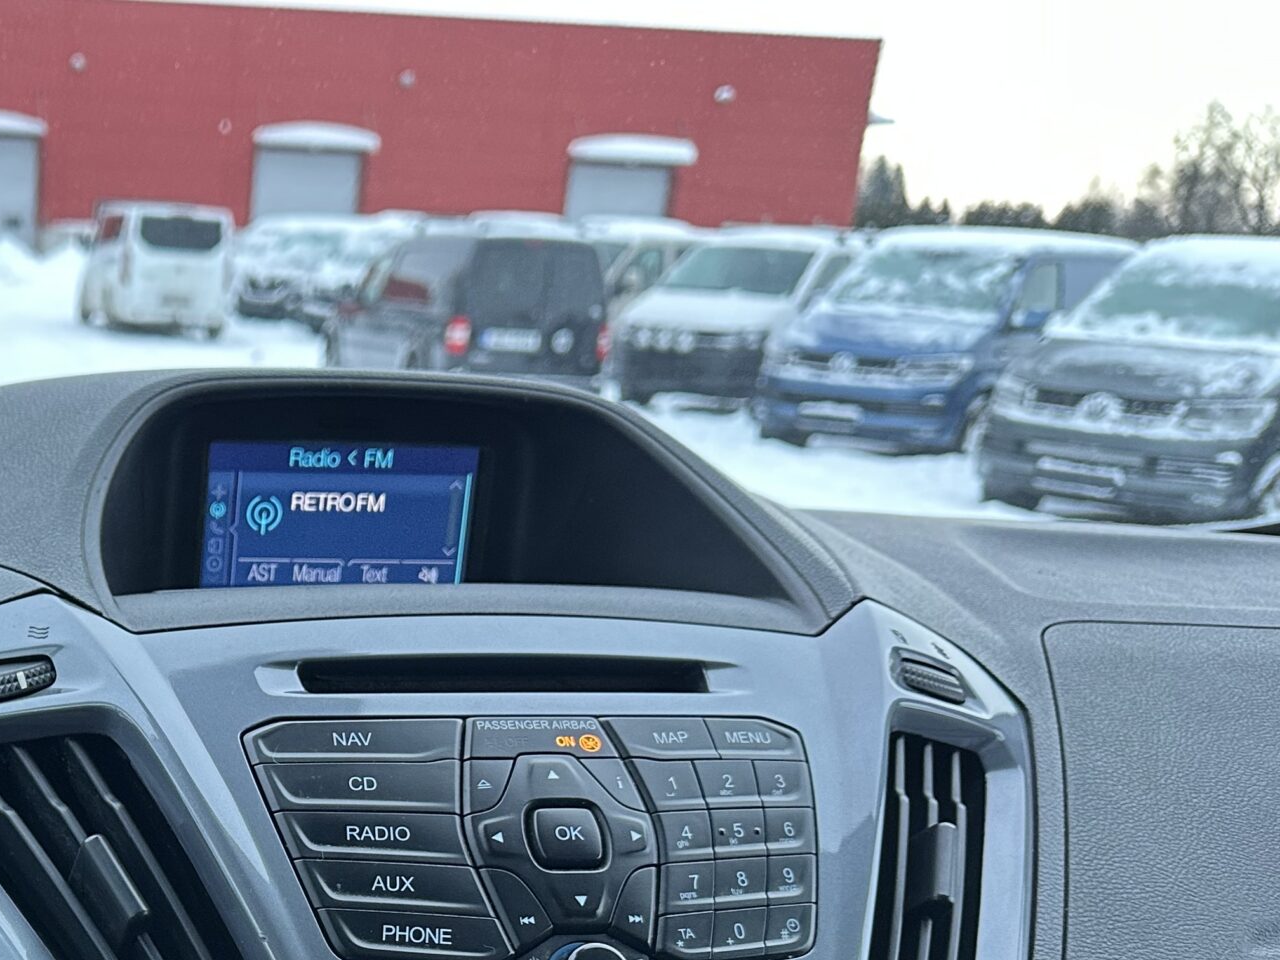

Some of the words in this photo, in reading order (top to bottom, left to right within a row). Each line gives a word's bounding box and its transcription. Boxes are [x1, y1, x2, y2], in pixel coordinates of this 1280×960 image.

[288, 447, 340, 468] Radio
[364, 449, 394, 468] FM
[247, 564, 277, 582] AST
[292, 564, 342, 583] Manual
[360, 565, 388, 583] Text
[476, 720, 550, 731] PASSENGER
[552, 720, 597, 731] AIRBAG
[332, 732, 372, 746] NAV
[555, 735, 576, 748] ON
[652, 731, 688, 745] MAP
[724, 731, 772, 745] MENU
[348, 776, 377, 791] CD
[667, 776, 678, 790] 1
[722, 774, 734, 788] 2
[774, 774, 786, 788] 3
[346, 825, 411, 841] RADIO
[554, 825, 585, 841] OK
[681, 825, 693, 840] 4
[733, 823, 745, 838] 5
[783, 821, 795, 837] 6
[371, 875, 415, 892] AUX
[688, 874, 699, 890] 7
[736, 871, 749, 887] 8
[782, 867, 795, 884] 9
[382, 924, 453, 945] PHONE
[677, 928, 696, 940] TA
[734, 923, 745, 940] 0
